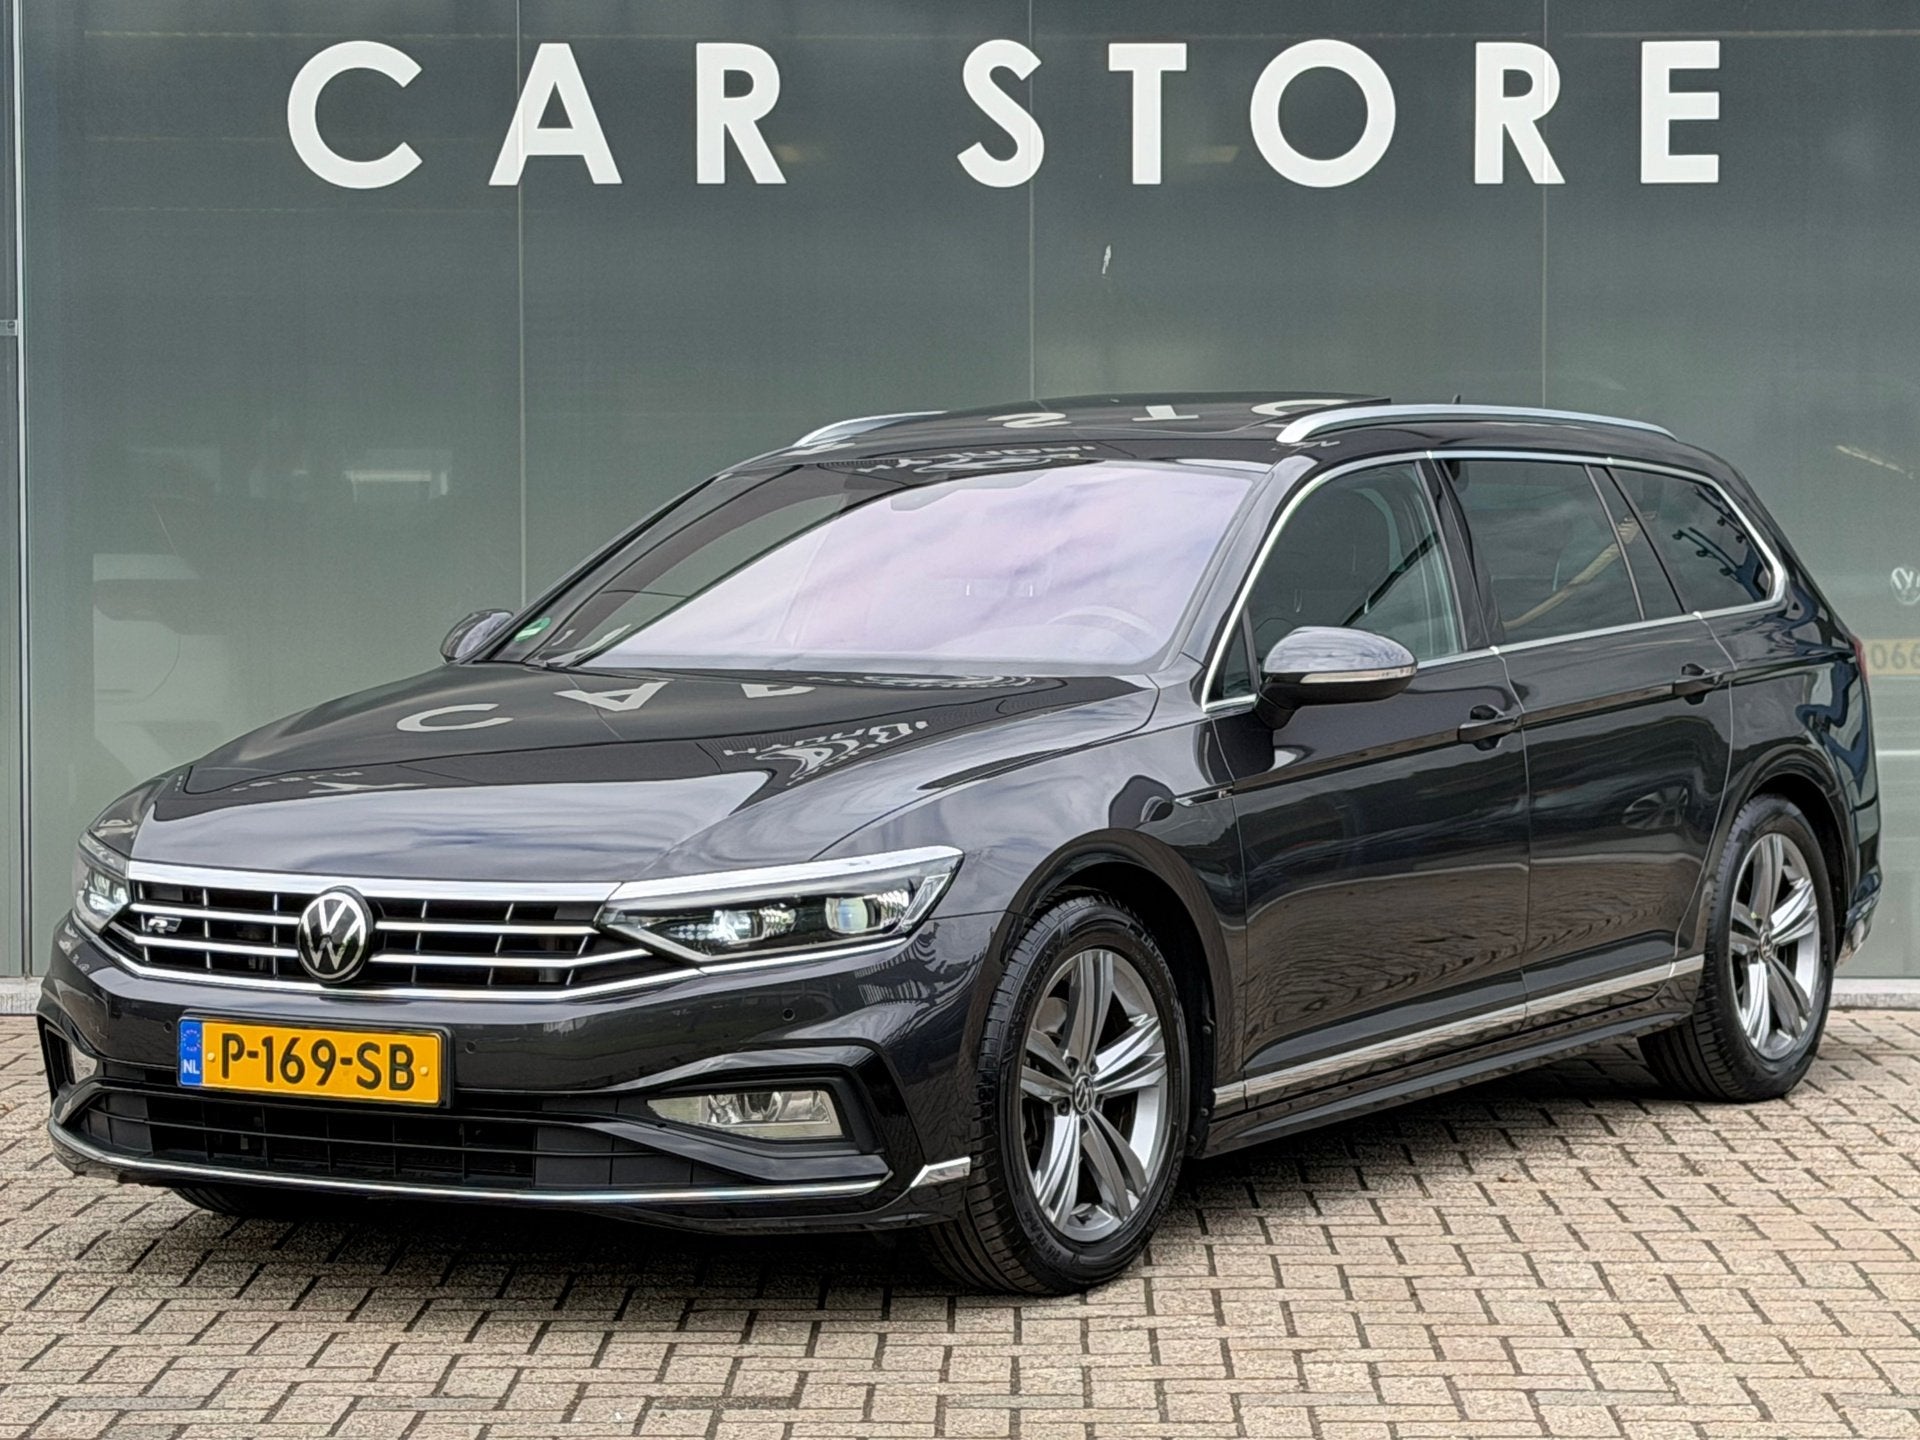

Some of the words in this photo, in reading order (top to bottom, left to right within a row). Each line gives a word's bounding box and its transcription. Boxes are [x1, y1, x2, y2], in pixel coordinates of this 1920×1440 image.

[288, 41, 785, 188] CAR
[958, 39, 1719, 187] STORE
[183, 1058, 200, 1075] NL
[221, 1032, 415, 1091] P-169-SB
